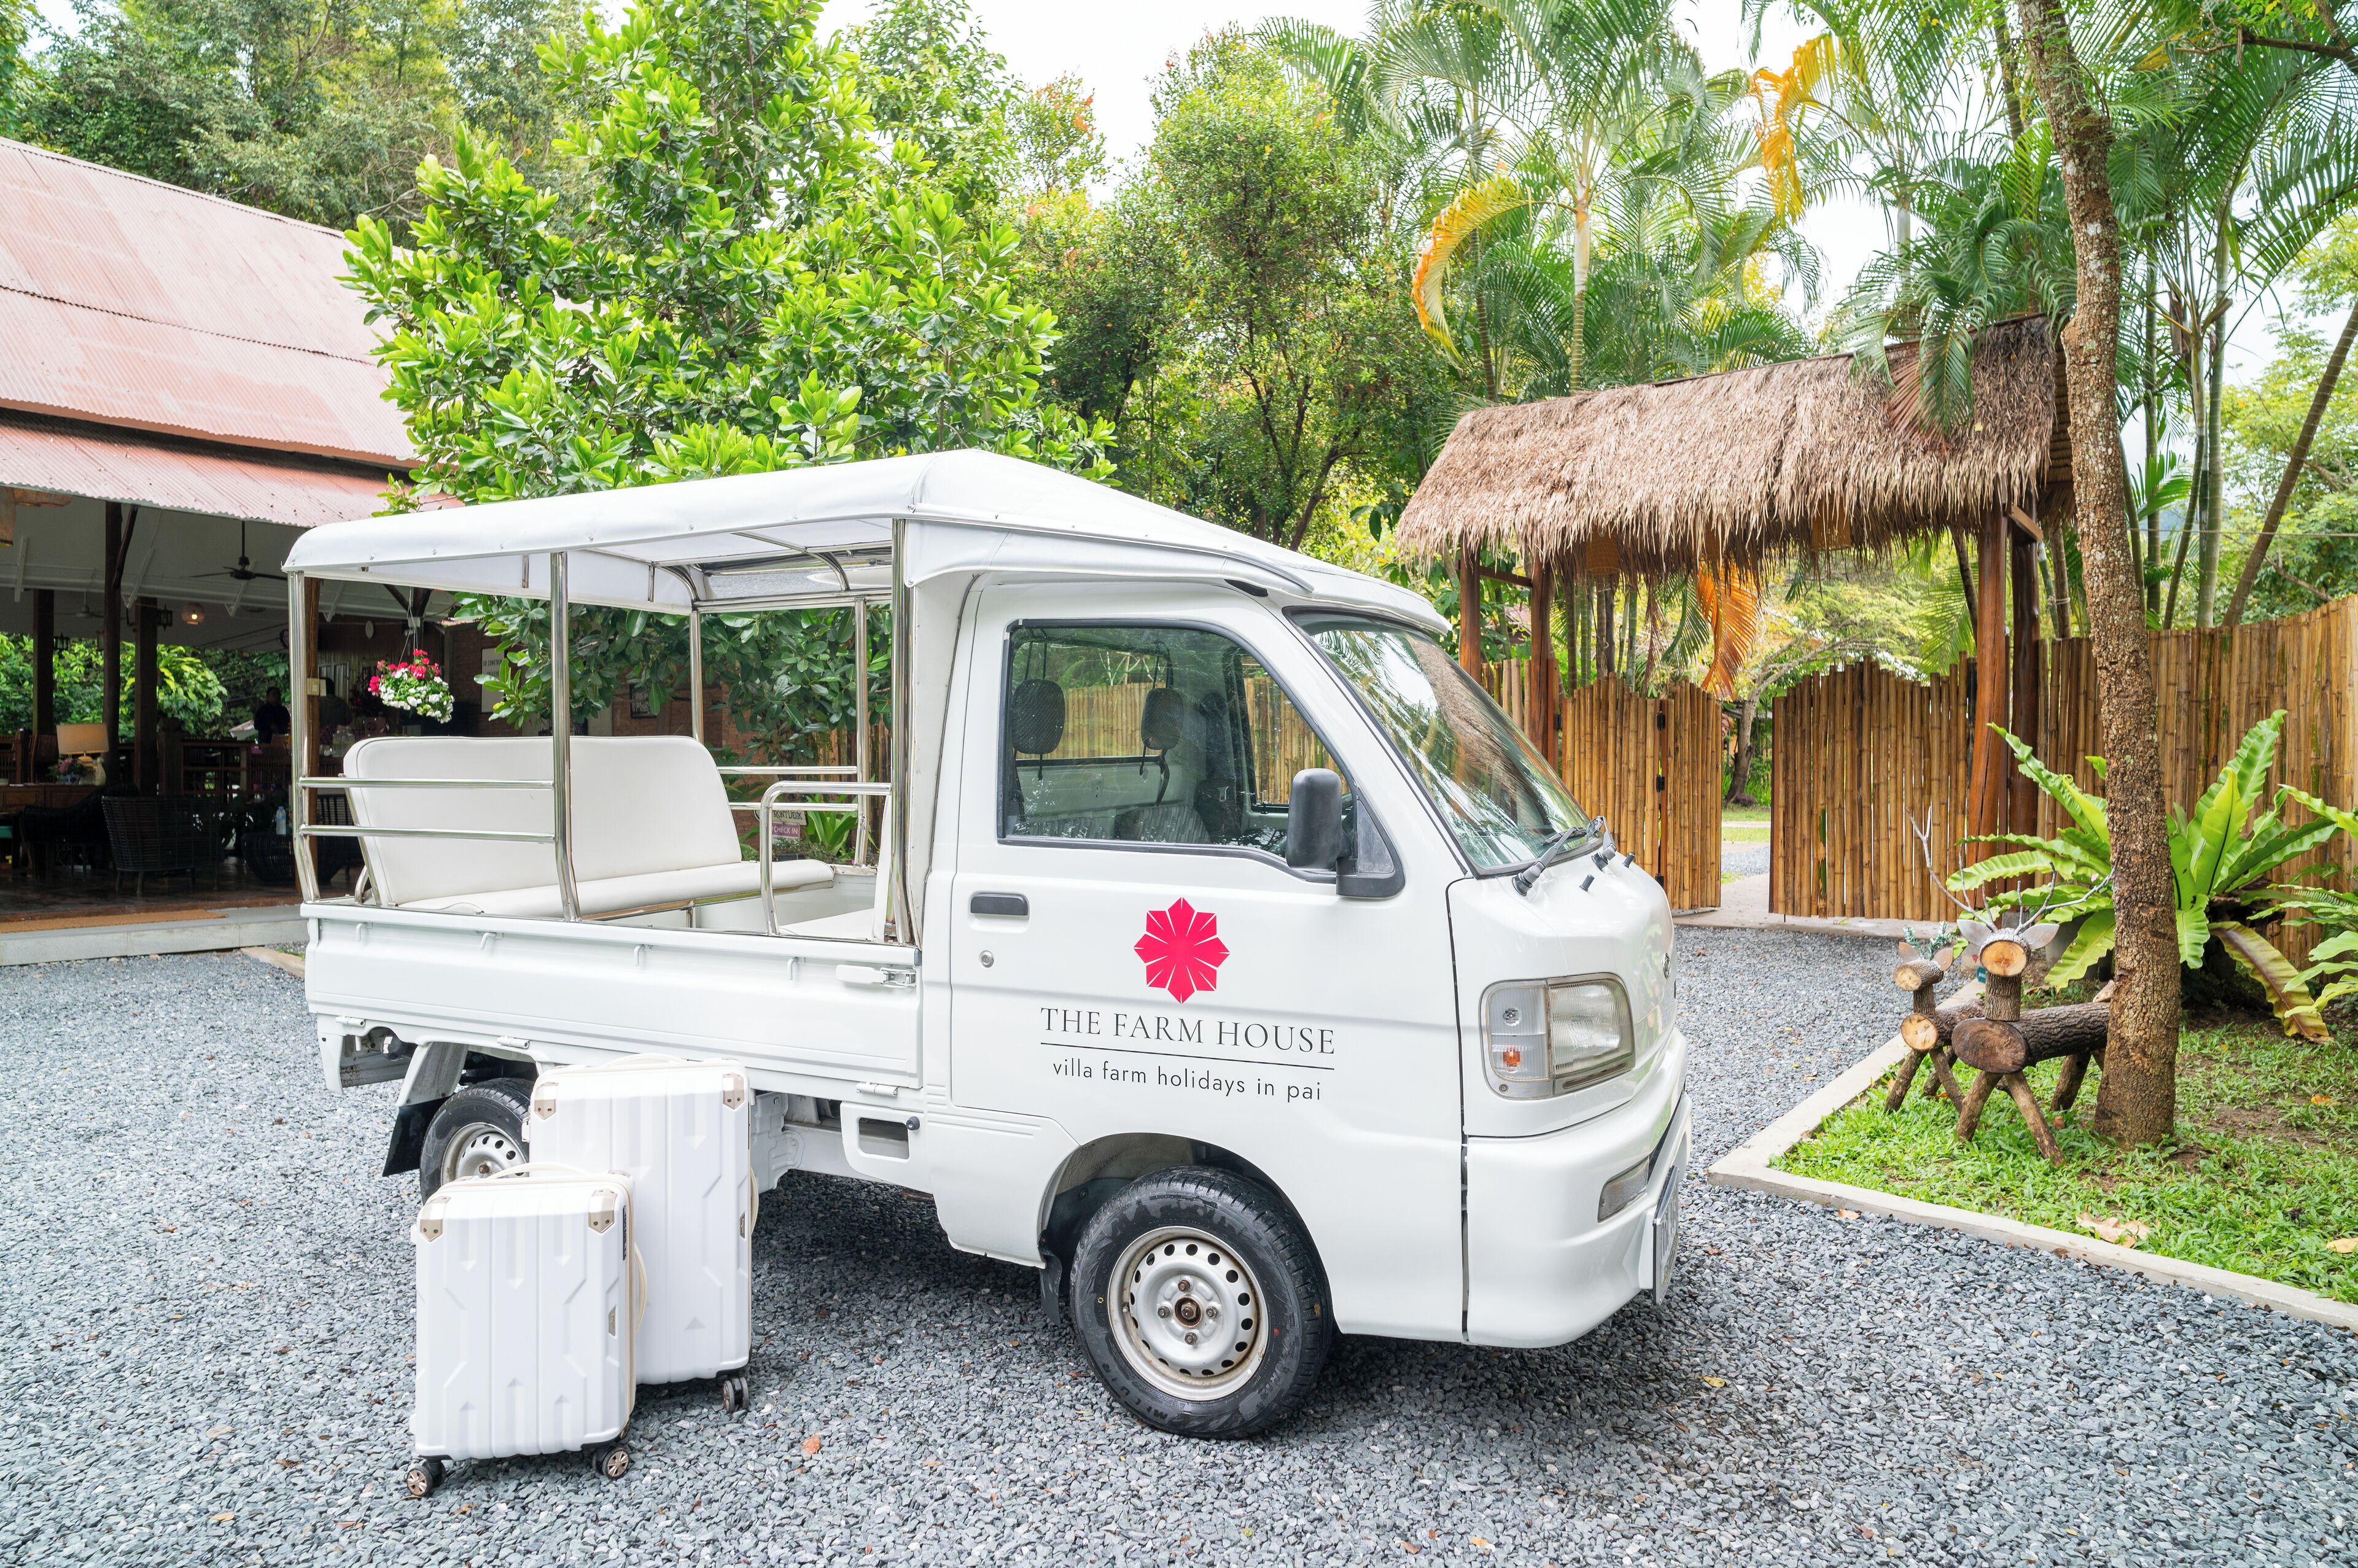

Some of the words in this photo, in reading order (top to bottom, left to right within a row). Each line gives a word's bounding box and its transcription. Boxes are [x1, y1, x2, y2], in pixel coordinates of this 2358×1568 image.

[788, 810, 803, 820] DESK
[1041, 1007, 1100, 1035] THE
[1114, 1013, 1204, 1044] FARM
[1216, 1020, 1335, 1055] HOUSE
[1053, 1058, 1092, 1079] villa
[1102, 1060, 1146, 1084] farm
[1158, 1065, 1245, 1097] holidays
[1257, 1077, 1275, 1095] in
[1286, 1082, 1321, 1104] pai
